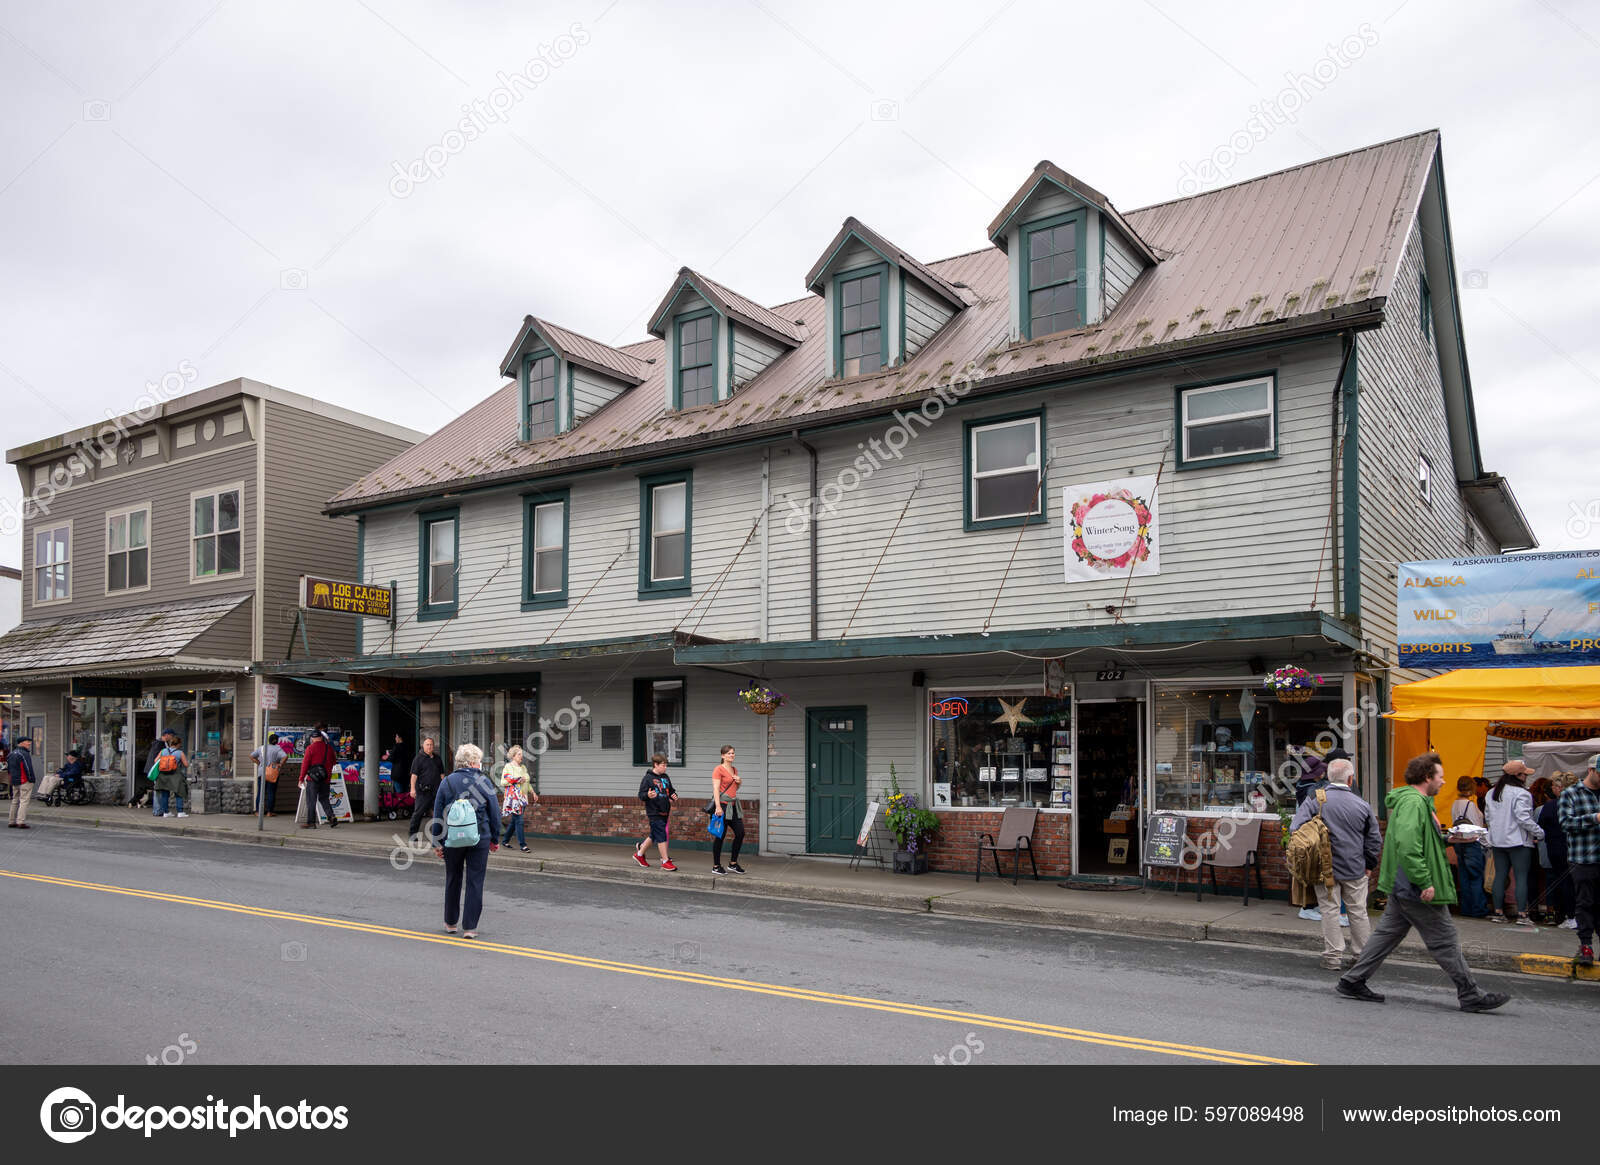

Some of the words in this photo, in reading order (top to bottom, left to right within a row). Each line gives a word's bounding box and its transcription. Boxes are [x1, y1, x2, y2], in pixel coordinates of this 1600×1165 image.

[1086, 523, 1135, 535] WinterSong
[1404, 575, 1466, 588] ALASKA
[332, 583, 351, 598] LOG
[354, 586, 390, 602] CACHE
[333, 597, 365, 613] GIFTS
[367, 600, 388, 609] CURIOS
[1413, 609, 1457, 621] WILD
[1401, 642, 1473, 654] EXPORTS
[1099, 671, 1122, 681] 202
[931, 702, 968, 716] OPEN
[1568, 726, 1600, 739] ALLE
